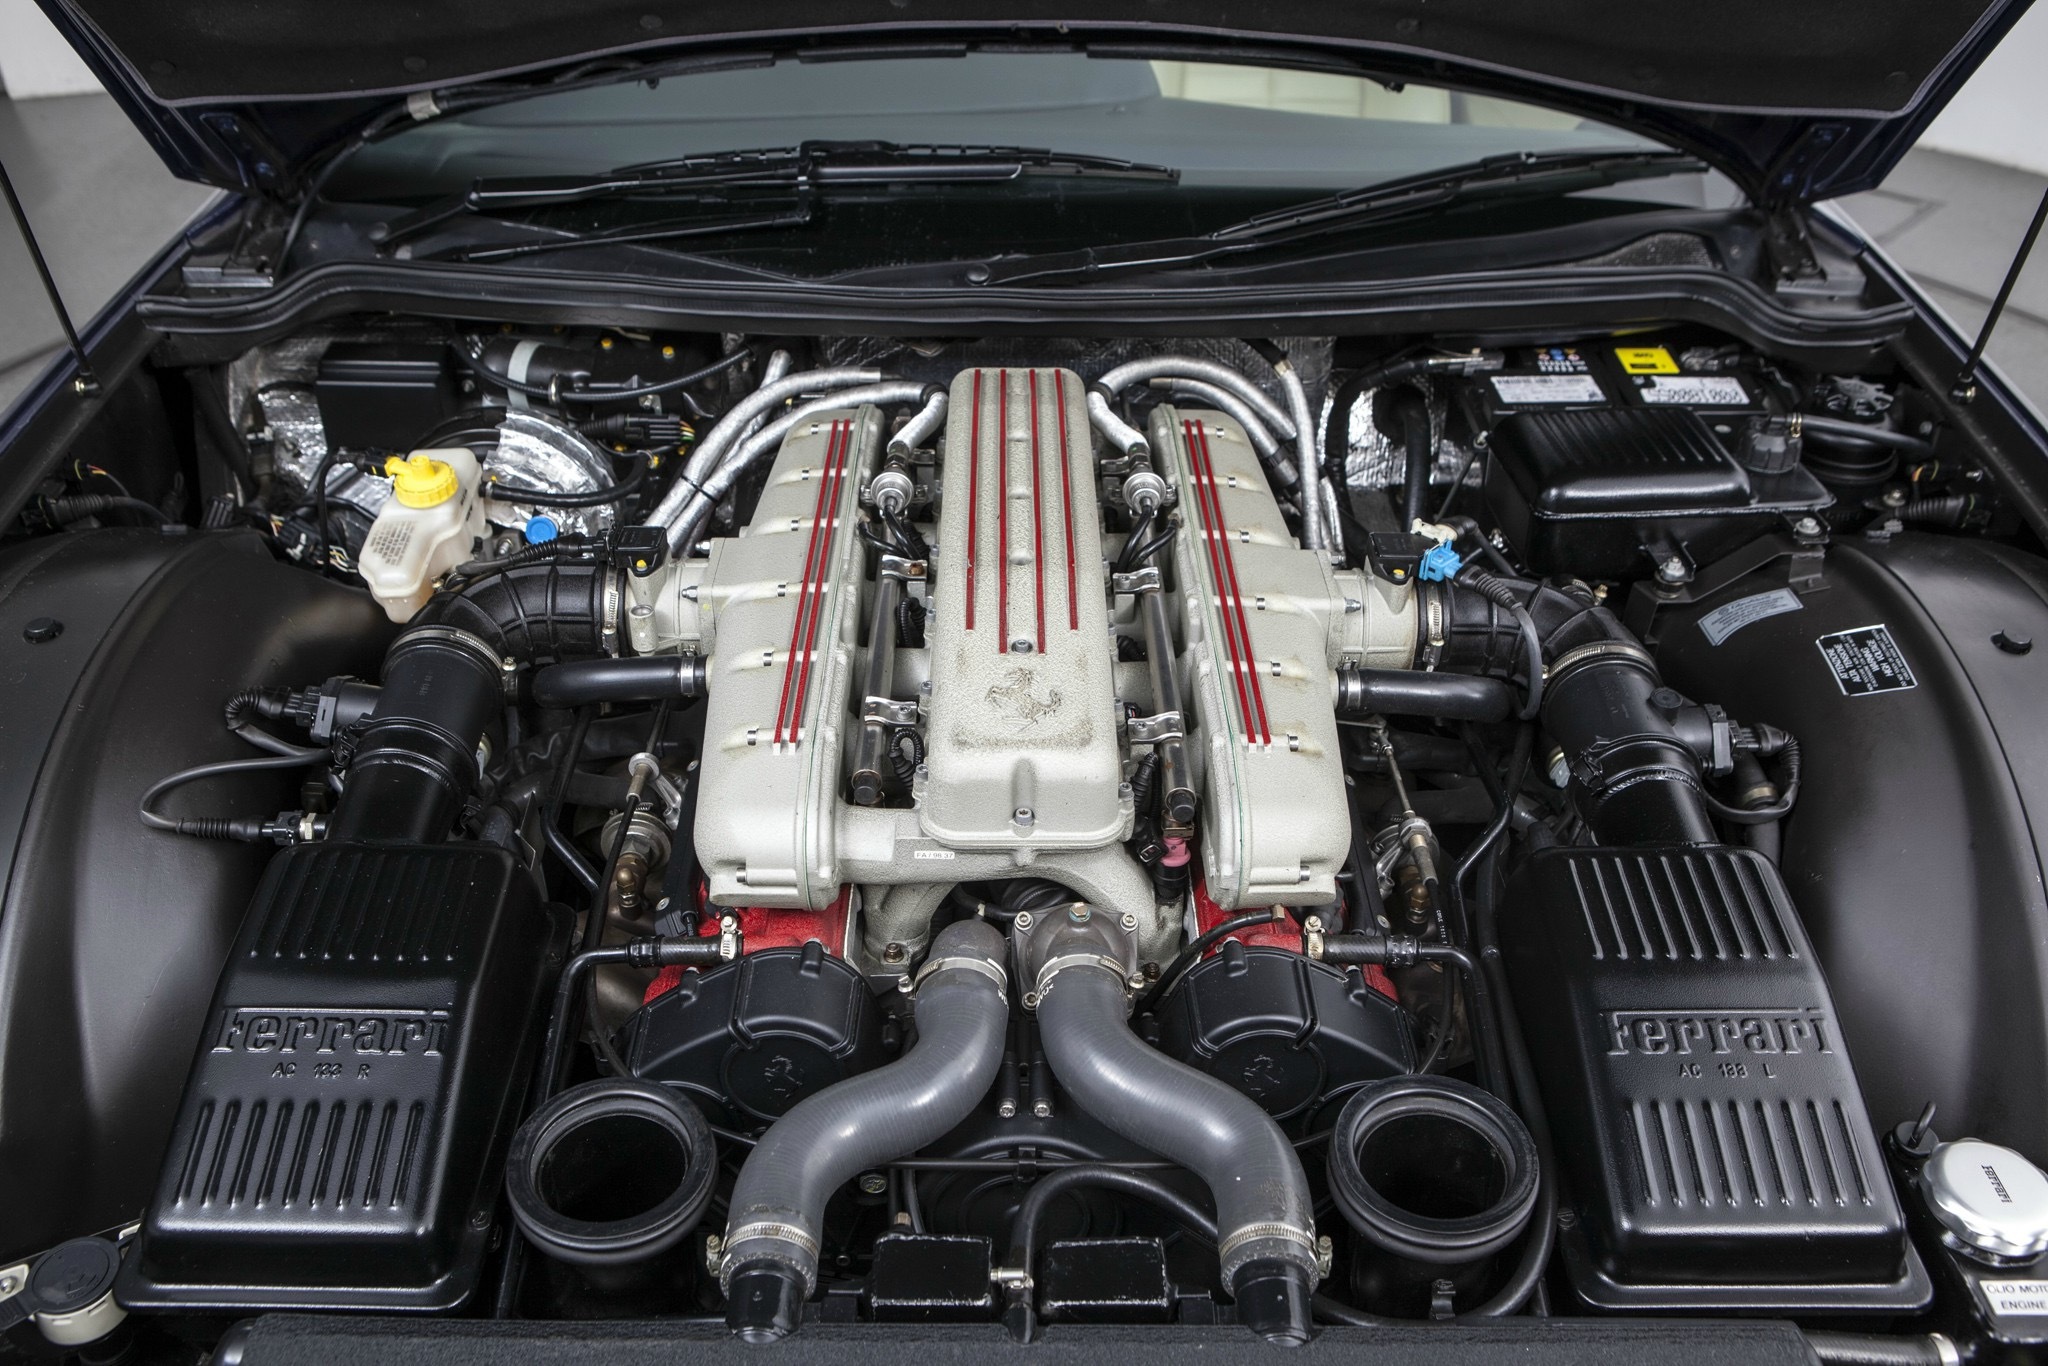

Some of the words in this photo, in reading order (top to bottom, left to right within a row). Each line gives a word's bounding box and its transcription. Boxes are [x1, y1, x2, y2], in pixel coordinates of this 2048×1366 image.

[1834, 644, 1852, 668] TENSIONE
[1861, 648, 1879, 671] WARNING
[1867, 640, 1884, 661] VOLTAGE
[1827, 649, 1848, 678] ATTENZIONE
[1881, 663, 1893, 676] HIGH
[1849, 669, 1861, 682] ALTA
[211, 1007, 449, 1056] Ferrari
[1607, 1008, 1832, 1055] Ferrari
[271, 1062, 297, 1079] AC
[357, 1064, 371, 1080] R
[1679, 1063, 1702, 1079] AC
[1762, 1063, 1777, 1079] L
[1981, 1164, 2013, 1203] Ferrari
[1986, 1284, 2015, 1294] OLIO
[2000, 1300, 2047, 1311] ENGINE
